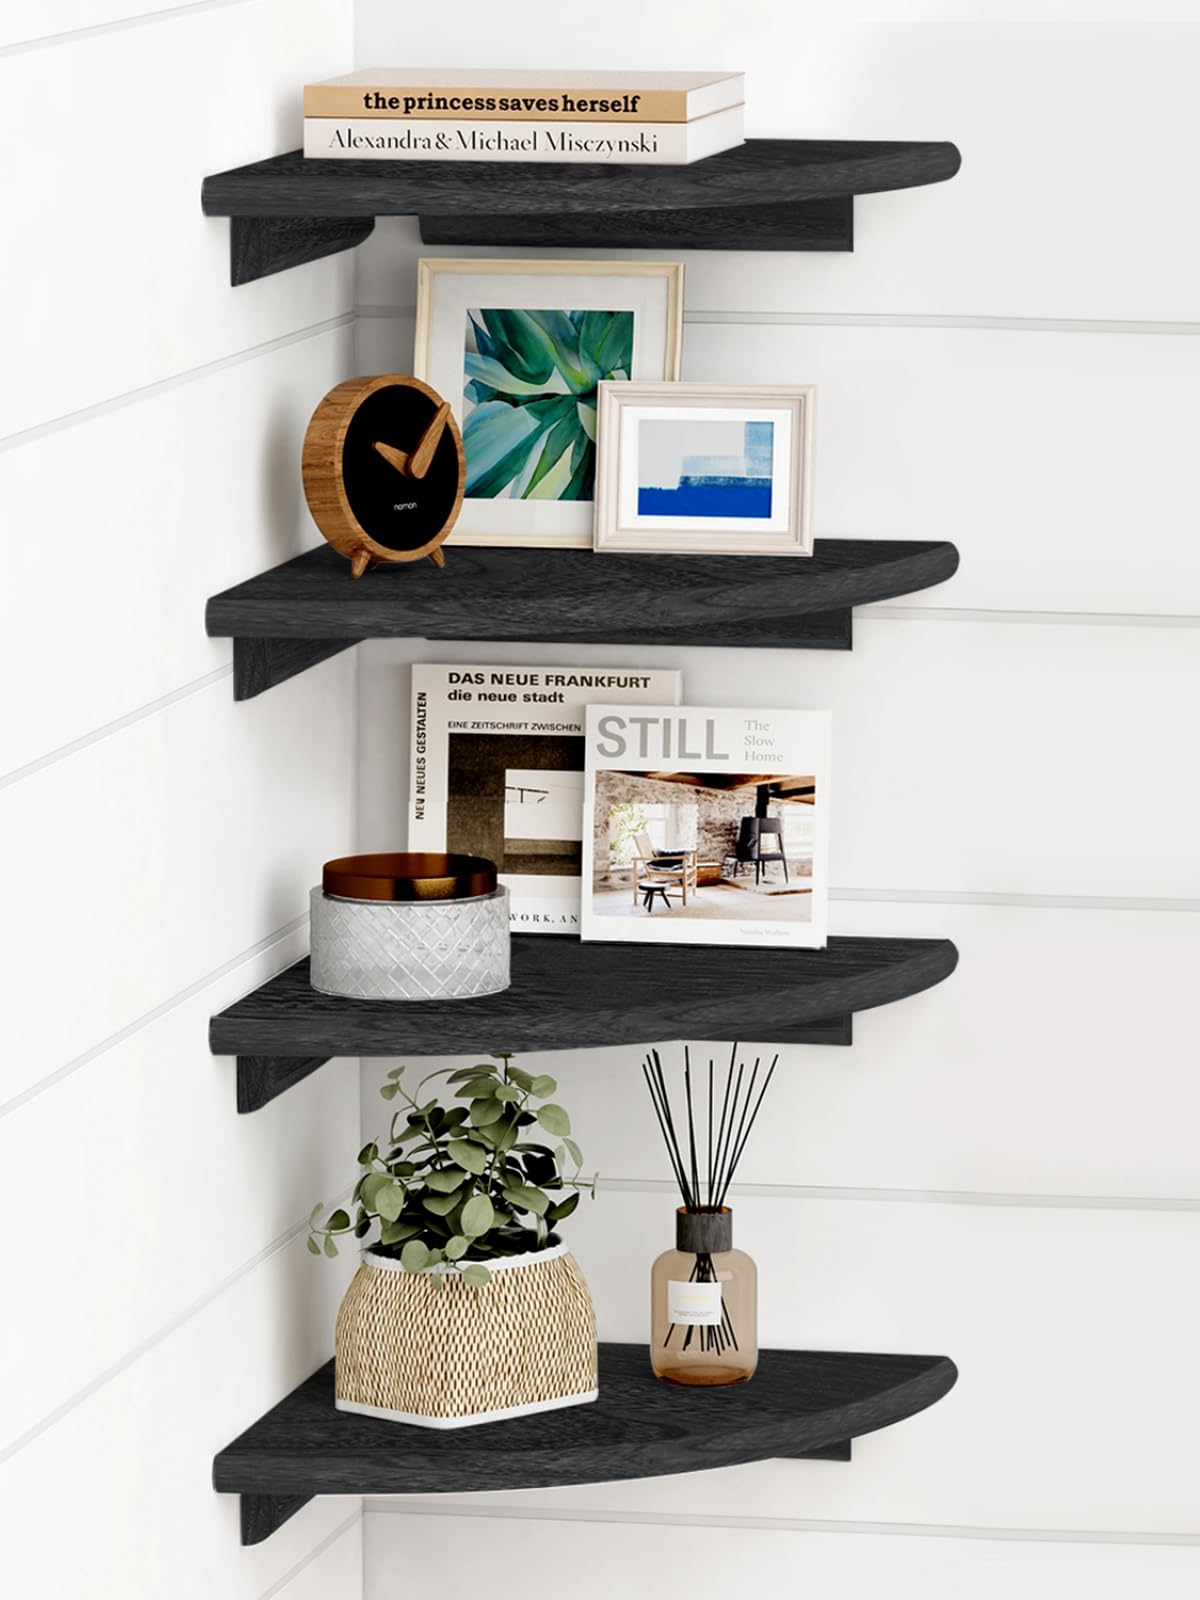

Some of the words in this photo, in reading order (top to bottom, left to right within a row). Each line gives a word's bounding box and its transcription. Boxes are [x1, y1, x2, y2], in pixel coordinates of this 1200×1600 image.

[363, 92, 400, 110] the
[403, 93, 497, 114] princess
[498, 99, 560, 112] saves
[561, 94, 641, 113] herself
[328, 128, 432, 151] Alexandra
[434, 130, 453, 150] &
[455, 130, 537, 152] Michael
[544, 131, 658, 159] Misczynski
[449, 672, 485, 685] DAS
[490, 674, 540, 687] NEUE
[544, 674, 651, 690] FRANKFURT
[447, 690, 473, 702] die
[477, 692, 518, 703] neue
[522, 692, 565, 704] stadt
[416, 691, 427, 754] GESTALTEN
[447, 720, 468, 730] EINE
[470, 721, 529, 732] ZEITSCHRIFT
[530, 723, 582, 733] ZWISCHEN
[744, 720, 770, 732] The
[596, 715, 730, 760] STILL
[744, 736, 775, 747] Slow
[744, 750, 784, 762] Home
[415, 756, 427, 793] NEUES
